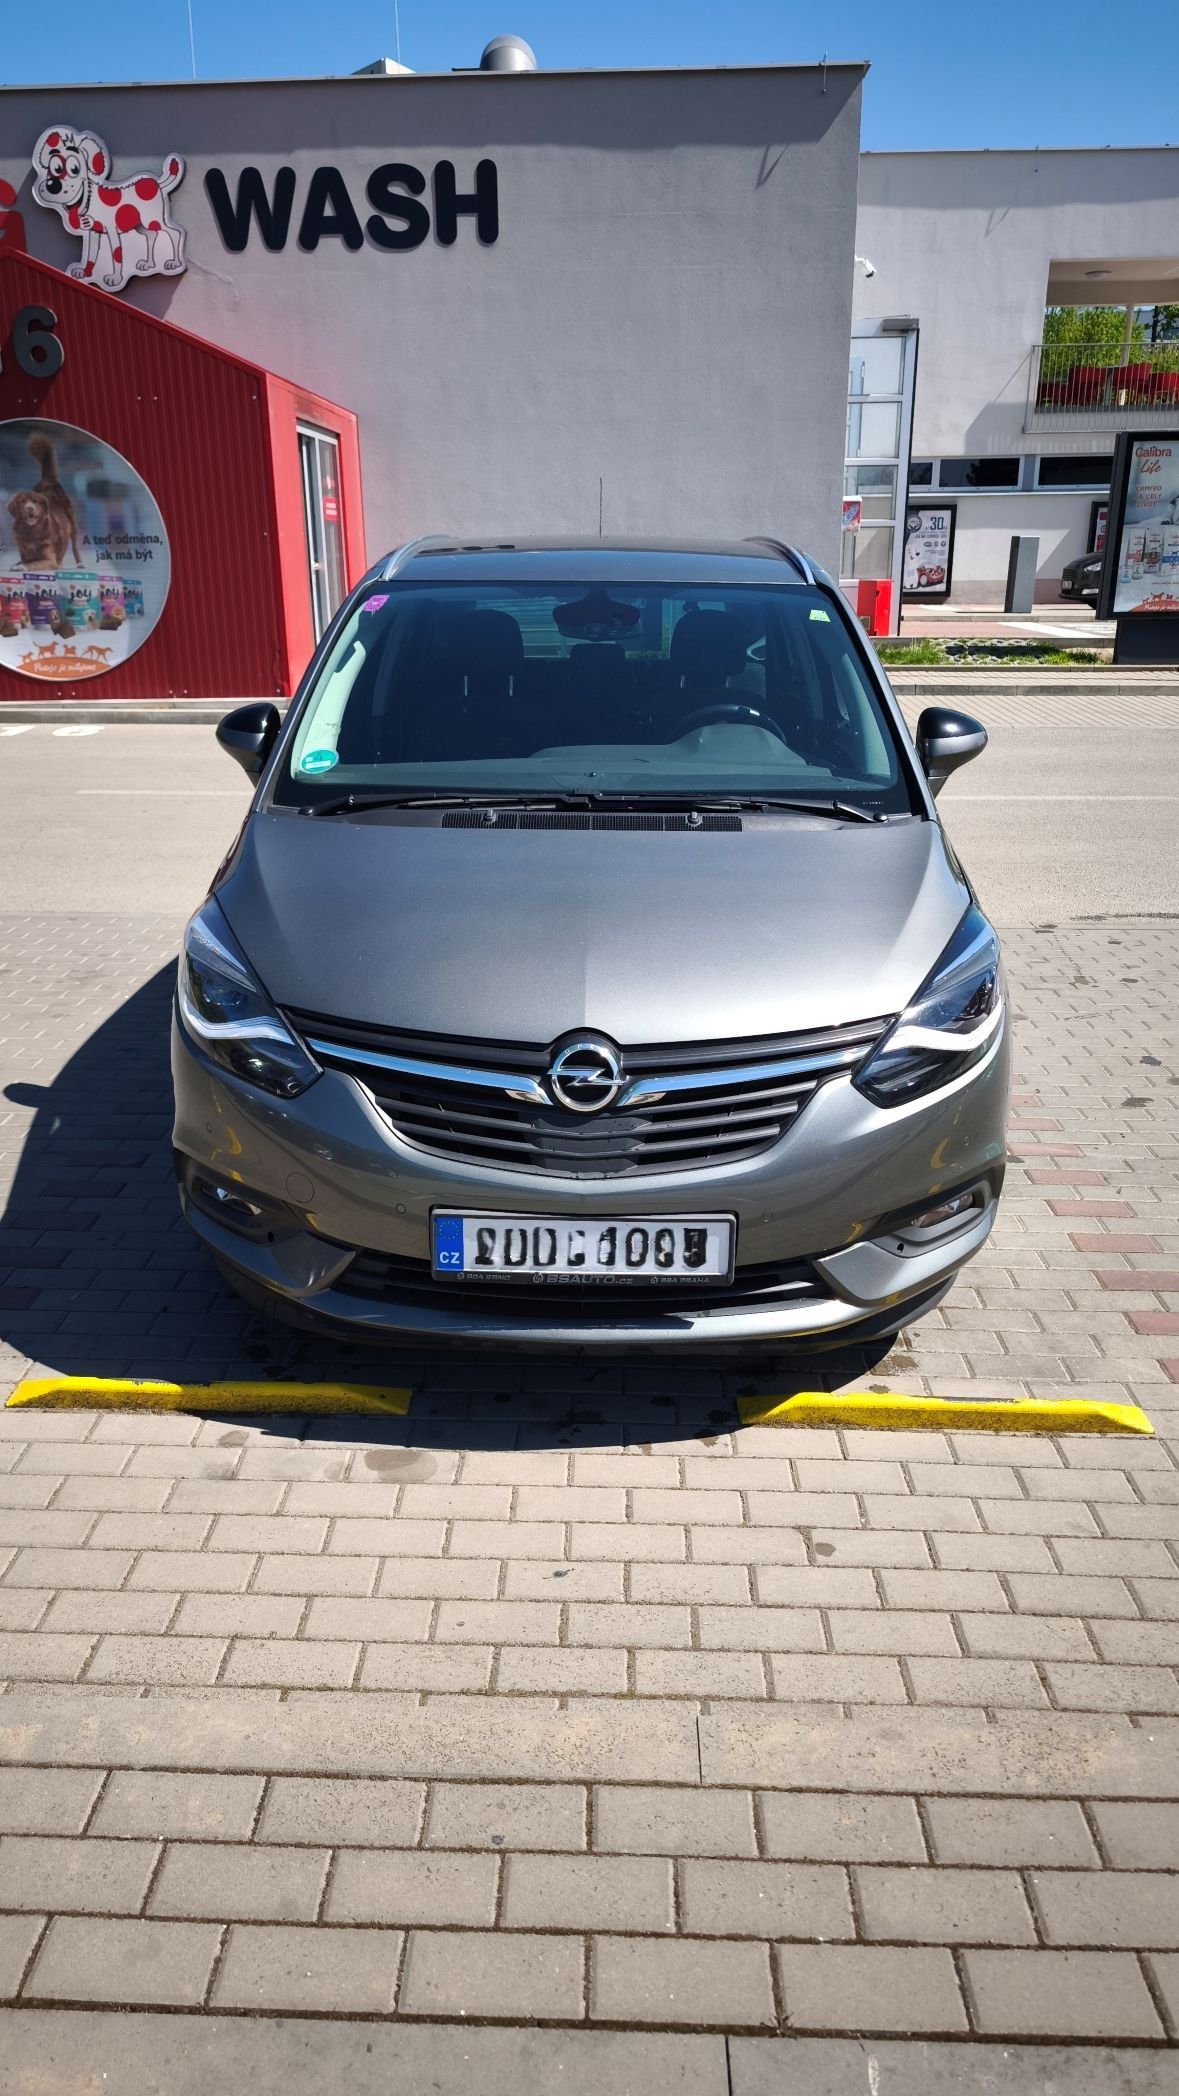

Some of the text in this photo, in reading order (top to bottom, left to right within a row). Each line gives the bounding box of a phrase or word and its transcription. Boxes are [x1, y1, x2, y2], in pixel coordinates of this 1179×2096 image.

[204, 158, 499, 251] WASH
[0, 304, 64, 378] 6
[1135, 446, 1172, 457] Calibra
[1139, 459, 1162, 474] Life
[930, 516, 945, 531] 30
[83, 534, 163, 547] A teď odměna,
[95, 550, 154, 563] jak má být
[67, 587, 93, 604] joy
[439, 1251, 460, 1264] CZ
